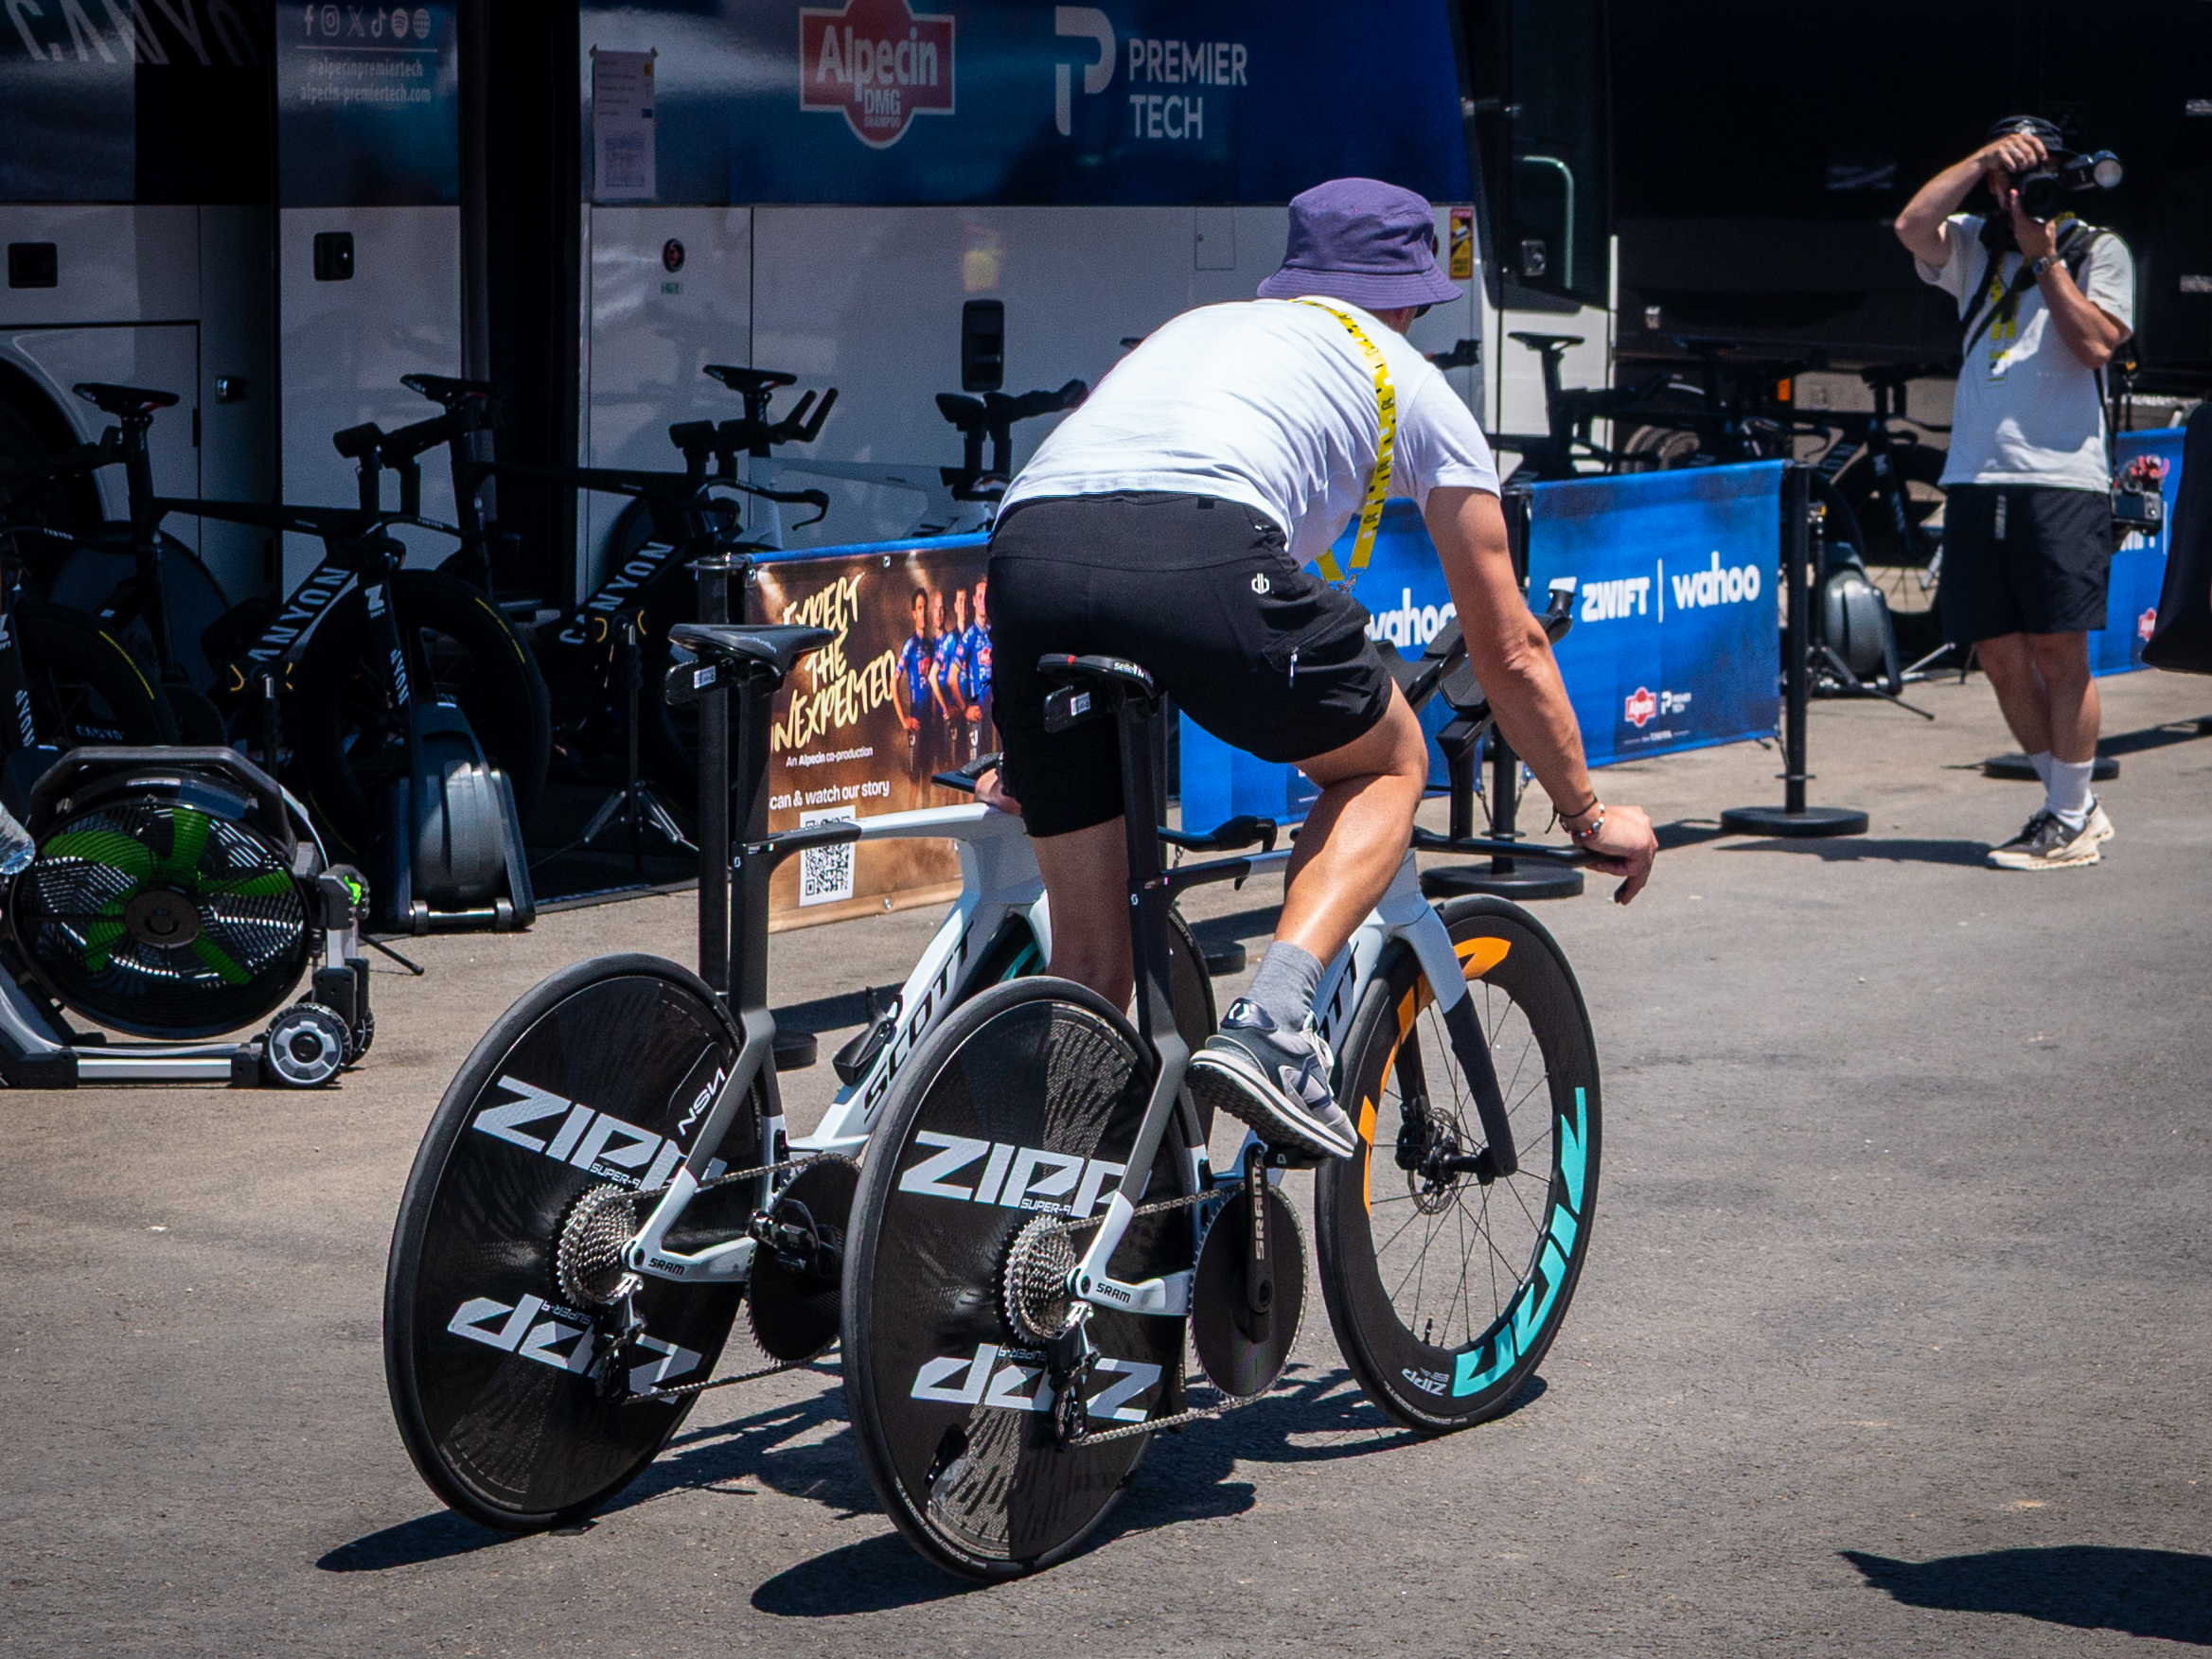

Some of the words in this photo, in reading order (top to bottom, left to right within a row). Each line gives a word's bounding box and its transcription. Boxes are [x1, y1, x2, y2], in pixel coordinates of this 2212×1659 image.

[815, 25, 938, 102] Alpecin
[1128, 38, 1248, 87] PREMIER
[863, 88, 901, 115] DMG
[1129, 94, 1203, 140] TECH
[1581, 575, 1651, 623] ZWIFT
[1672, 551, 1761, 610] wahoo
[248, 566, 351, 662] ANYON
[805, 627, 849, 693] THE
[786, 756, 798, 768] An
[799, 751, 825, 768] Alpecin
[825, 746, 873, 763] co-production
[769, 794, 791, 810] can
[793, 789, 803, 807] &
[805, 785, 841, 805] watch
[841, 784, 859, 801] our
[861, 780, 890, 798] story
[864, 920, 975, 1123] SCOTT
[591, 1162, 642, 1189] SUPER-9
[1019, 1198, 1071, 1215] SUPER-9
[1252, 1166, 1264, 1260] SRAM
[648, 1257, 685, 1276] SRAM
[1096, 1282, 1131, 1304] SRAM
[1402, 1368, 1447, 1396] ZIPP
